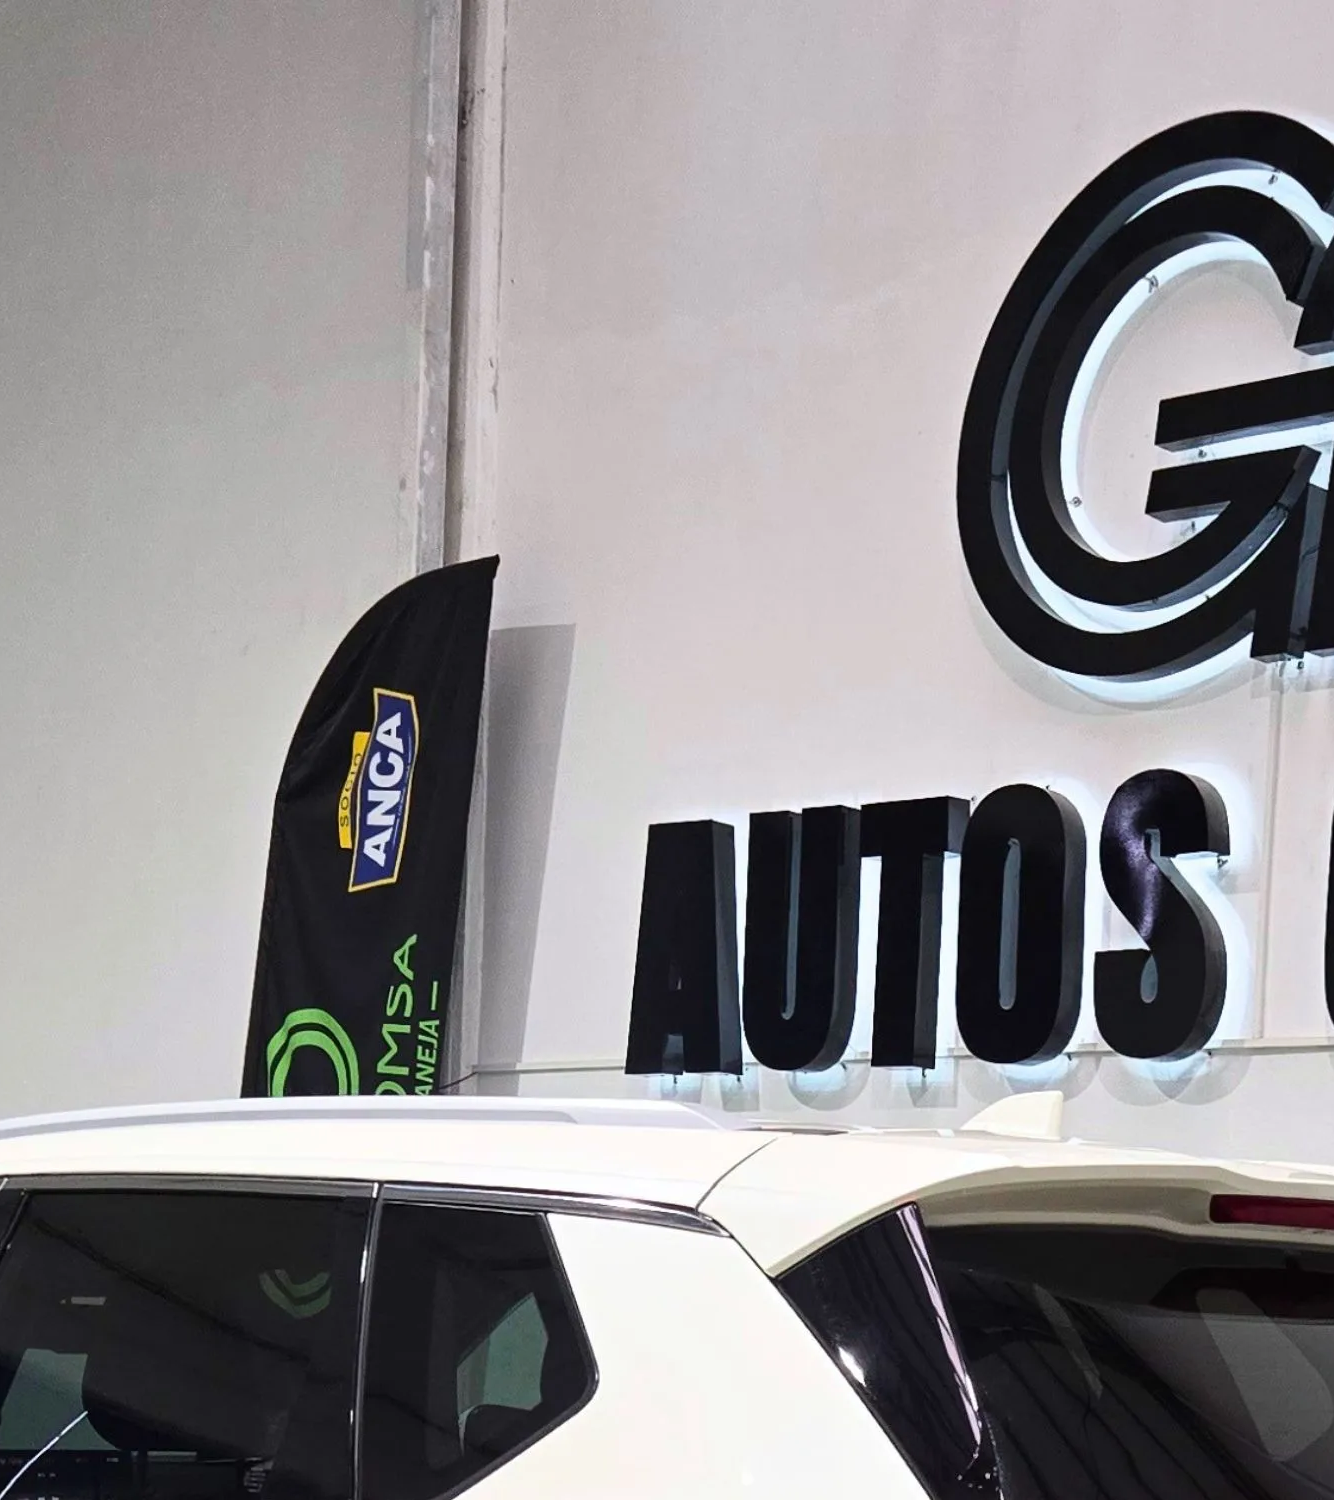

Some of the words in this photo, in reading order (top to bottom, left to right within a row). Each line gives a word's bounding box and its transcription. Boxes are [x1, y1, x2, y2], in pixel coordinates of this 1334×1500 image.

[340, 752, 364, 828] SOCIO
[363, 712, 405, 867] ANCA
[625, 767, 1231, 1076] AUTOS
